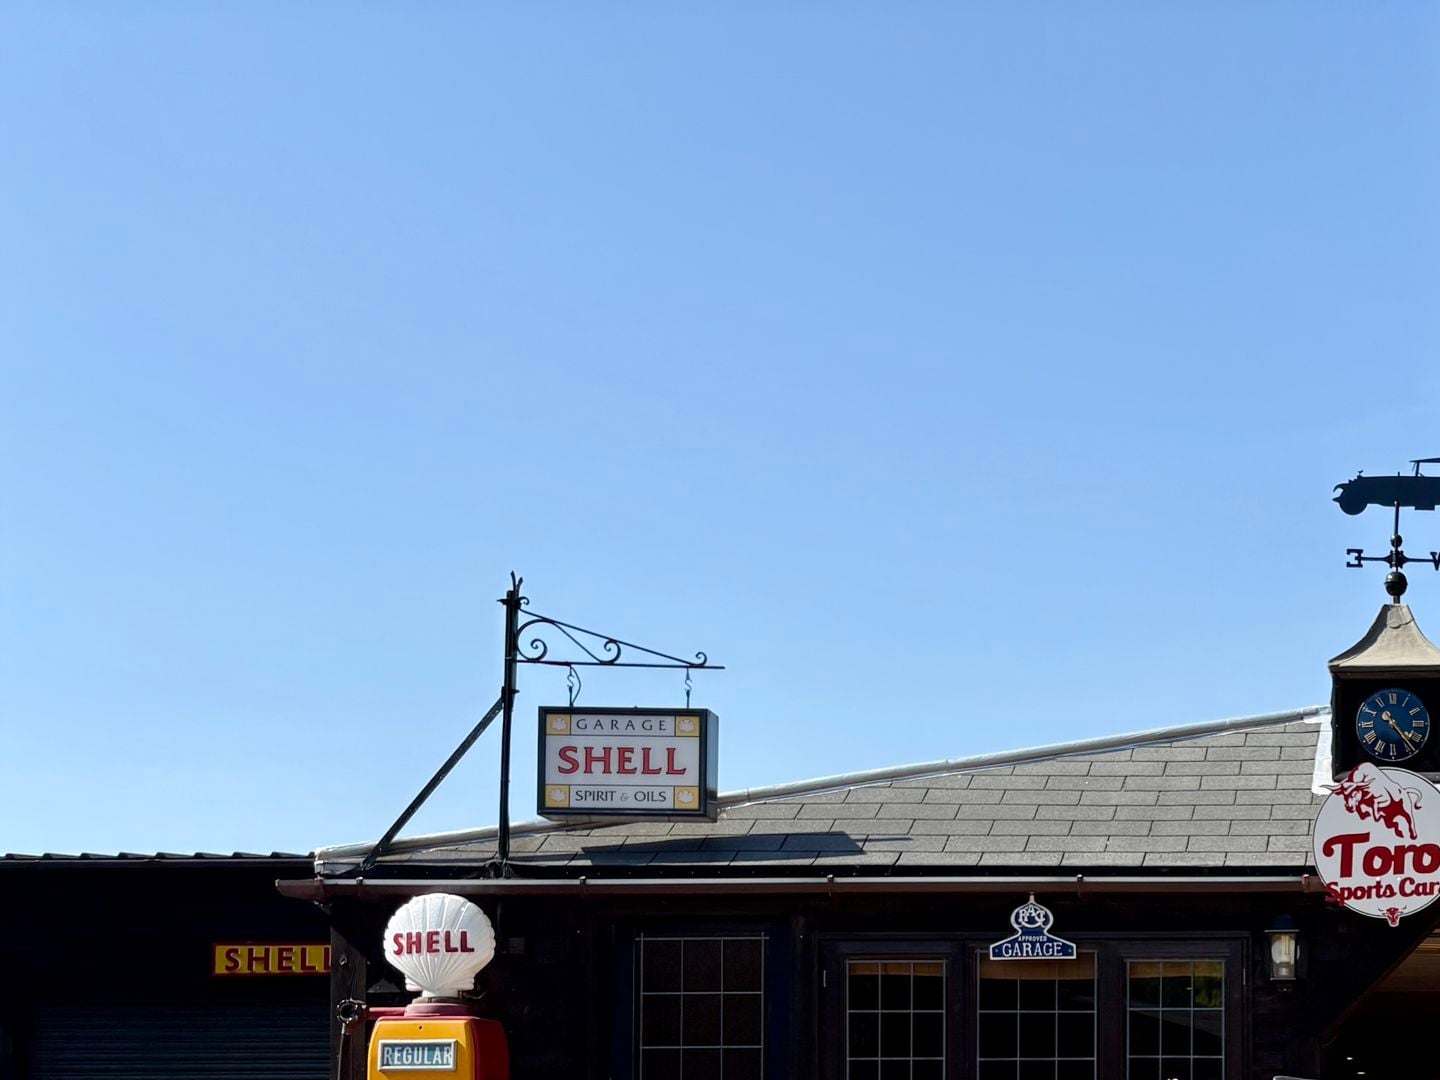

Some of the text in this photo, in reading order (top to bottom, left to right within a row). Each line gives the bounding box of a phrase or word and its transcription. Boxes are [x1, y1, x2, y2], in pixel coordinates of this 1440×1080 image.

[576, 719, 667, 731] GARAGE
[558, 745, 687, 775] SHELL
[576, 790, 616, 801] SPIRIT
[634, 791, 667, 802] OILS
[1325, 880, 1397, 906] Sports
[393, 930, 475, 956] SHELL
[1002, 942, 1063, 956] GARAGE
[383, 1046, 452, 1065] REGULAR
